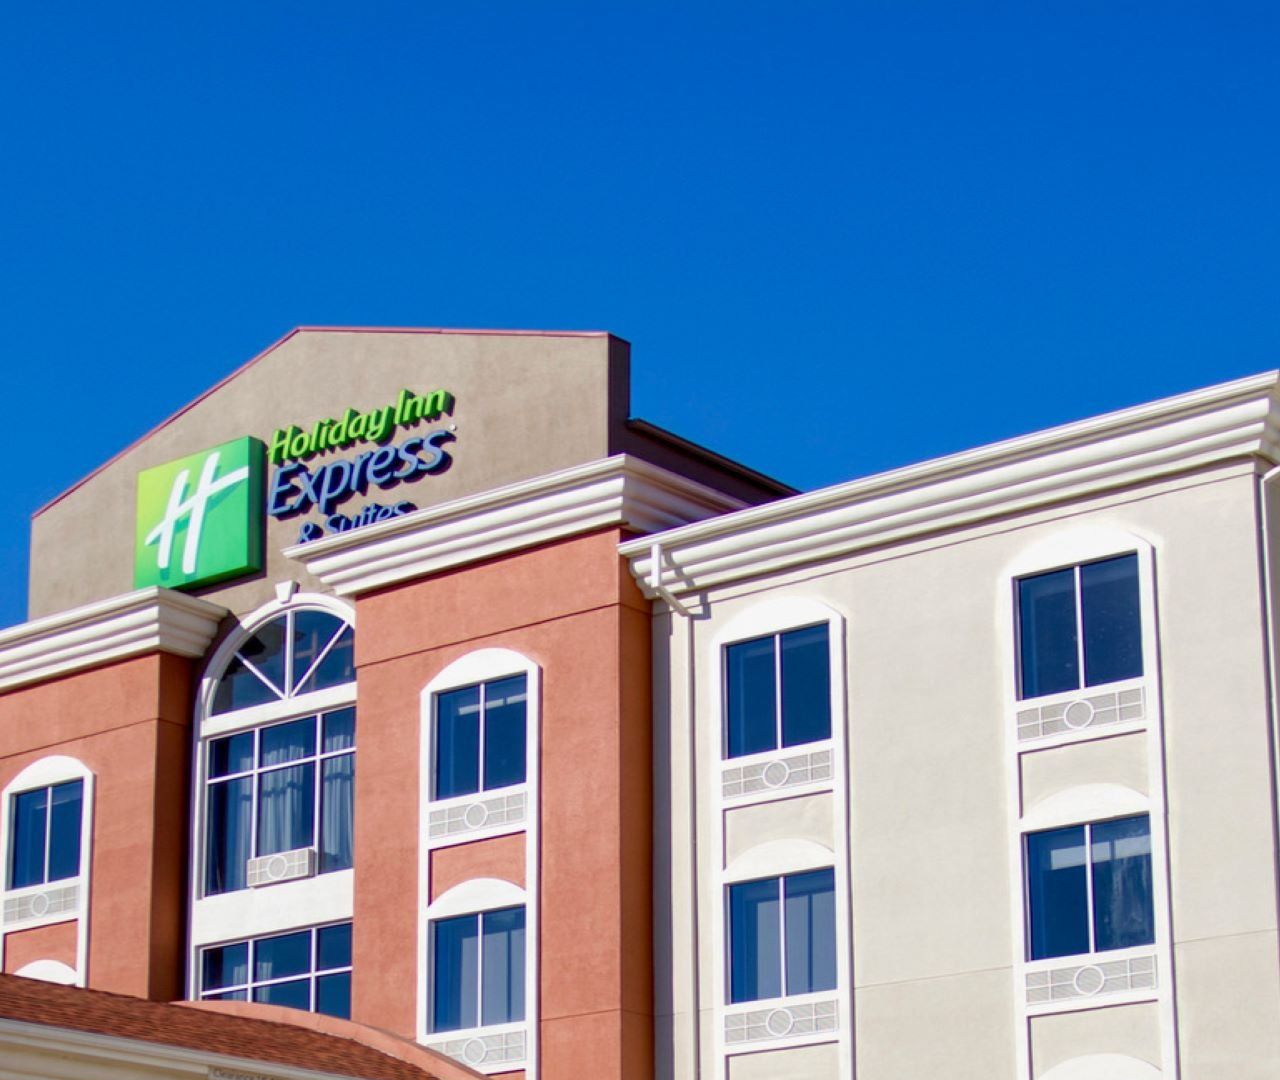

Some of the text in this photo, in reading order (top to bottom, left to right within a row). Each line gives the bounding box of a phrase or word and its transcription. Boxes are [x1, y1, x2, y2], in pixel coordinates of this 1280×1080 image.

[268, 389, 455, 465] Holiday Inn
[267, 429, 458, 520] Express
